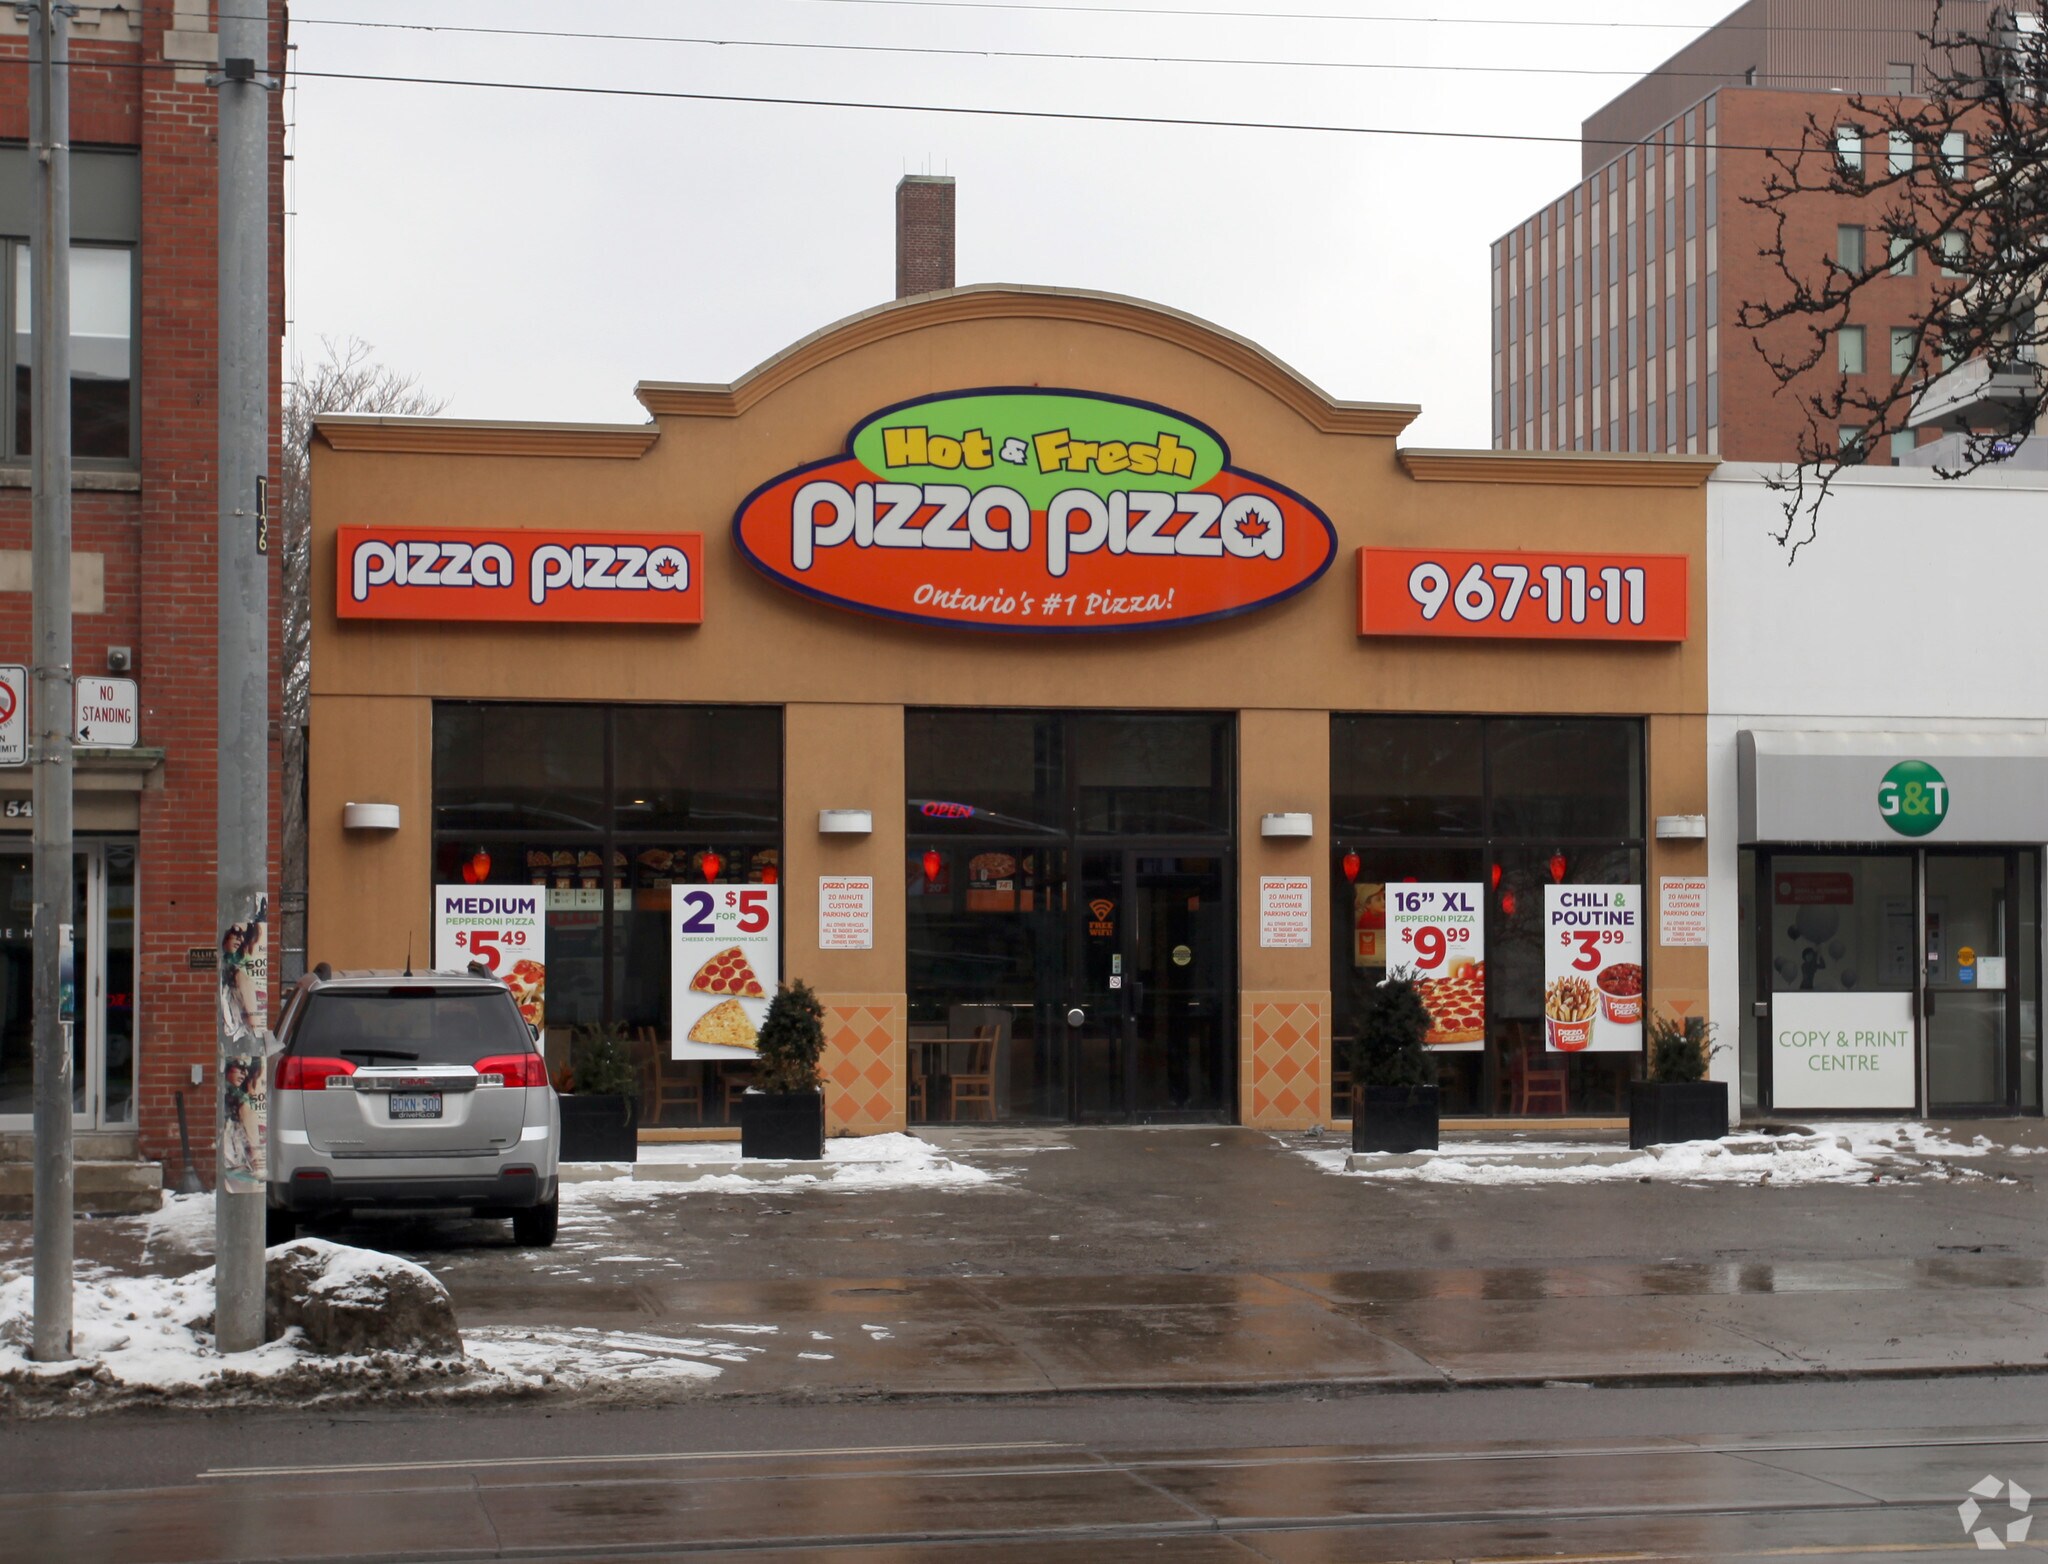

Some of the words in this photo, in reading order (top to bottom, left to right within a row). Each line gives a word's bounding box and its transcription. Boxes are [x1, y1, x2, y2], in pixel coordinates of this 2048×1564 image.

[882, 425, 994, 470] Hot
[999, 437, 1029, 466] &
[1032, 427, 1196, 480] Fresh
[791, 481, 1031, 571] pizza
[1046, 487, 1284, 578] pizza
[353, 540, 513, 601] pizza
[530, 543, 689, 605] pizza
[913, 583, 1035, 616] Ontario's
[1041, 592, 1078, 616] #1
[1084, 588, 1175, 616] Pizza!
[100, 686, 113, 701] NO
[82, 706, 131, 723] STANDING
[1879, 781, 1947, 816] G&T
[922, 801, 974, 818] OPEN
[823, 883, 845, 891] pizza
[846, 883, 869, 891] pizza
[1264, 883, 1285, 891] pizza
[1286, 883, 1308, 891] pizza
[446, 898, 535, 914] MEDIUM
[1442, 892, 1475, 912] XL
[1560, 893, 1609, 907] CHILI
[1613, 893, 1626, 907] &
[682, 890, 715, 933] 2
[715, 912, 736, 921] FOR
[1552, 911, 1635, 926] POUTINE
[446, 917, 503, 926] PEPPERONI
[505, 917, 535, 926] PIZZA
[1779, 1031, 1830, 1047] COPY
[1836, 1031, 1849, 1047] &
[1855, 1031, 1908, 1047] PRINT
[1808, 1055, 1879, 1071] CENTRE
[400, 1078, 433, 1086] GMC
